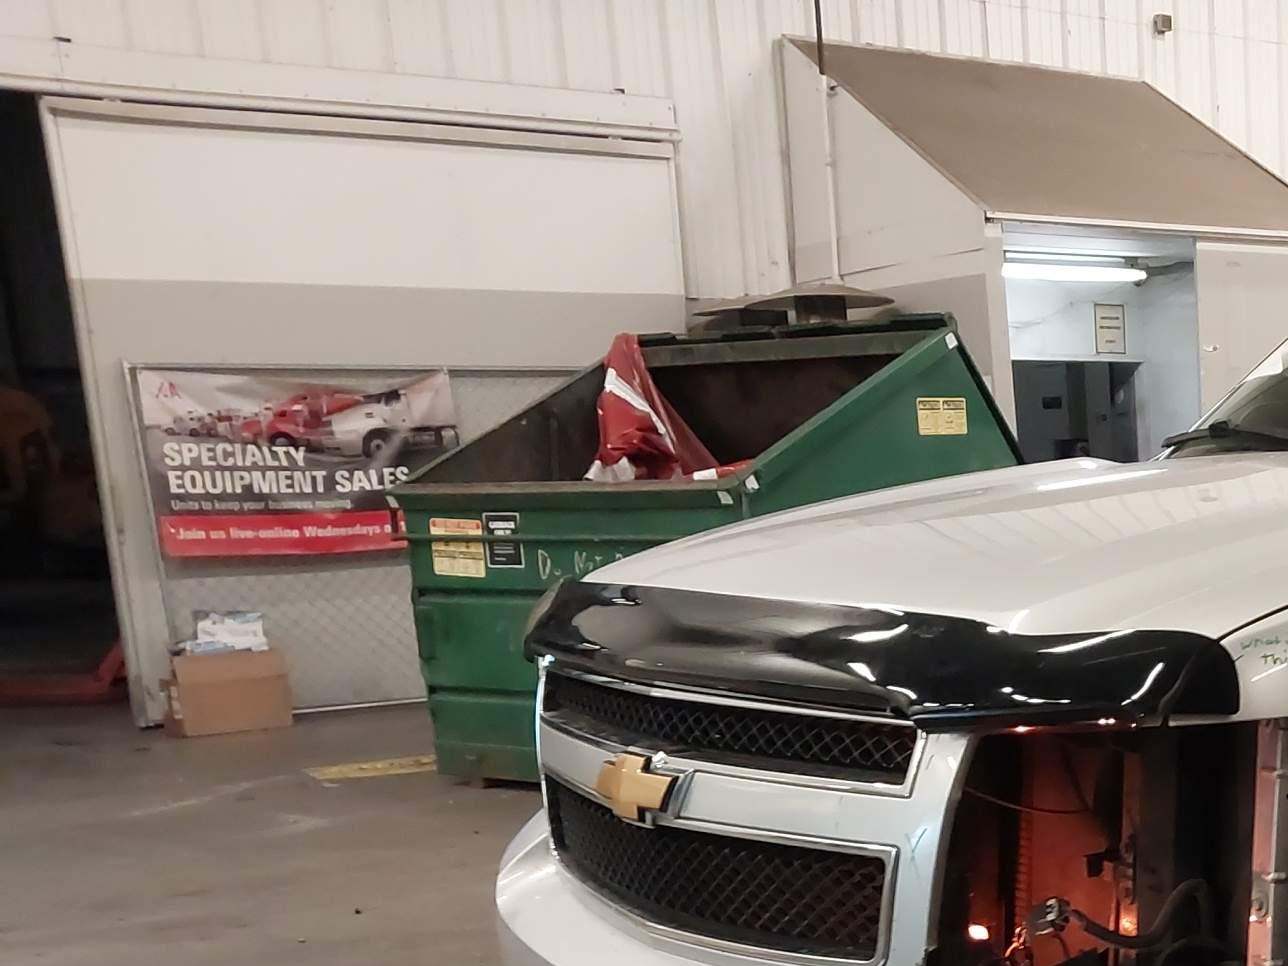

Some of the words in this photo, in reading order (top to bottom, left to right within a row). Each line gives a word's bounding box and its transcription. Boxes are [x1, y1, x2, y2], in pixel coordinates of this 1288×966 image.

[164, 442, 306, 467] SPECIALTY
[168, 470, 327, 494] EQUIPMENT
[335, 466, 409, 493] SALES
[302, 523, 380, 538] Wednesdays
